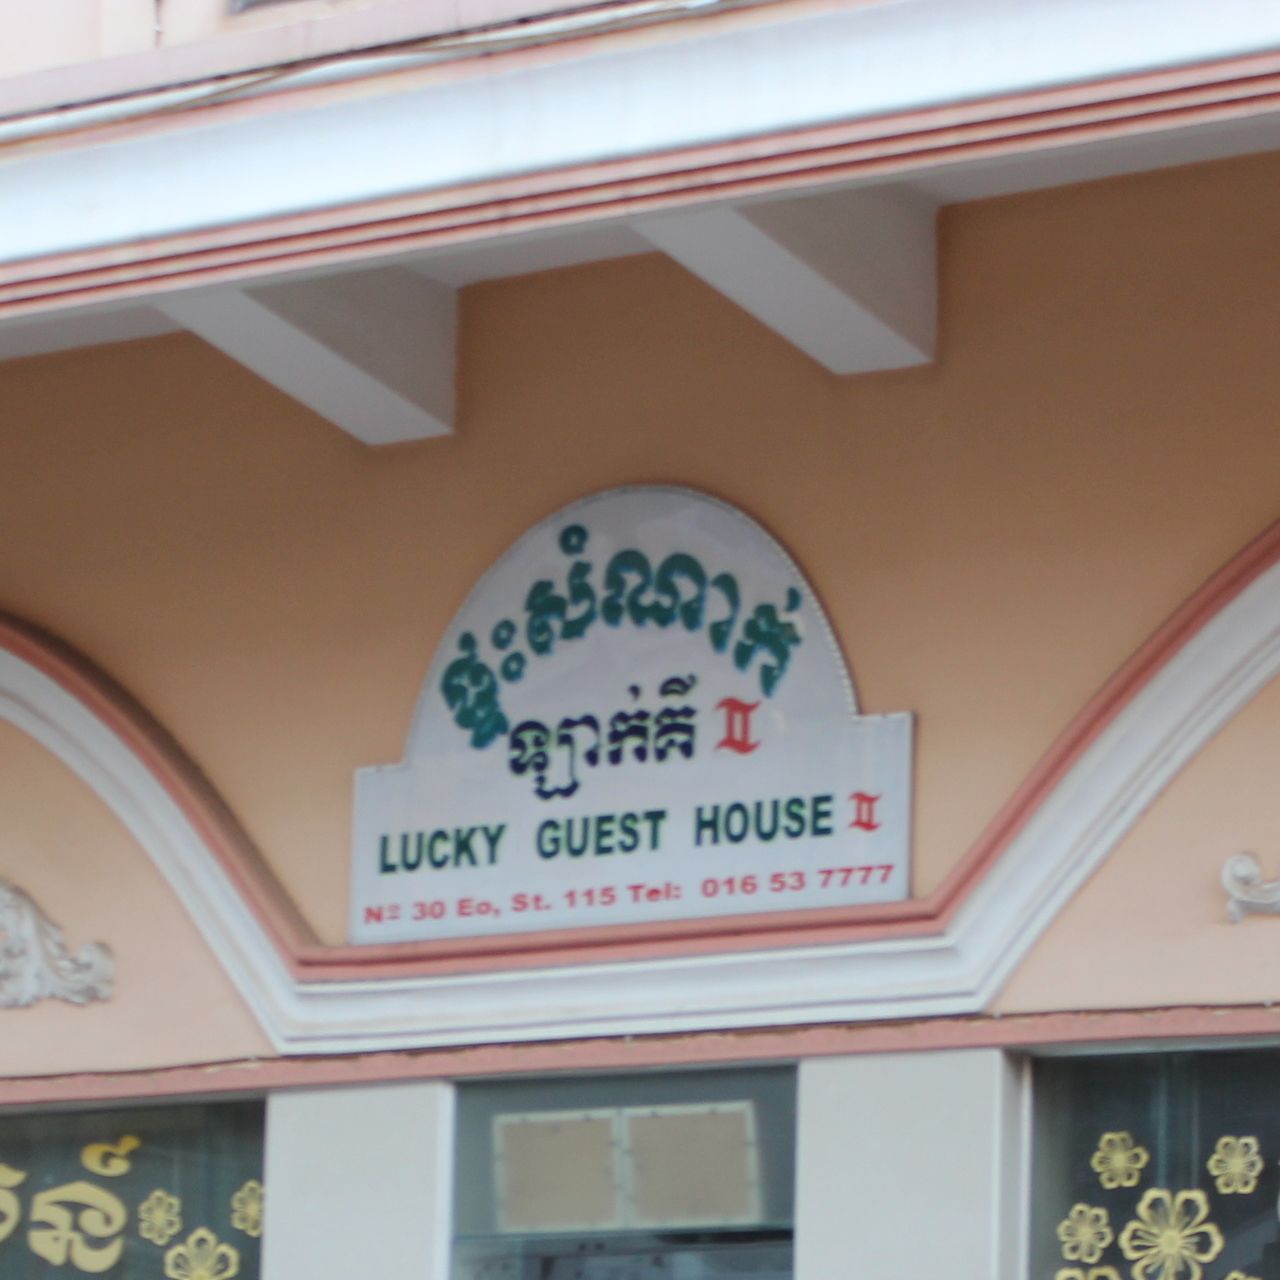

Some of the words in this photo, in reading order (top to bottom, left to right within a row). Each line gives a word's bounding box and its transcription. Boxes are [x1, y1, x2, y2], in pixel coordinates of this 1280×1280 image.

[379, 823, 507, 875] LUCKY
[536, 809, 668, 860] GUEST
[694, 794, 836, 848] HOUSE
[848, 791, 883, 833] II
[412, 900, 447, 921] 30
[456, 897, 501, 919] Eo,
[510, 892, 552, 914] St.
[563, 885, 617, 908] 115
[627, 882, 682, 904] Tel:
[700, 873, 759, 899] 016
[768, 870, 806, 894] 53
[816, 863, 895, 889] 7777
